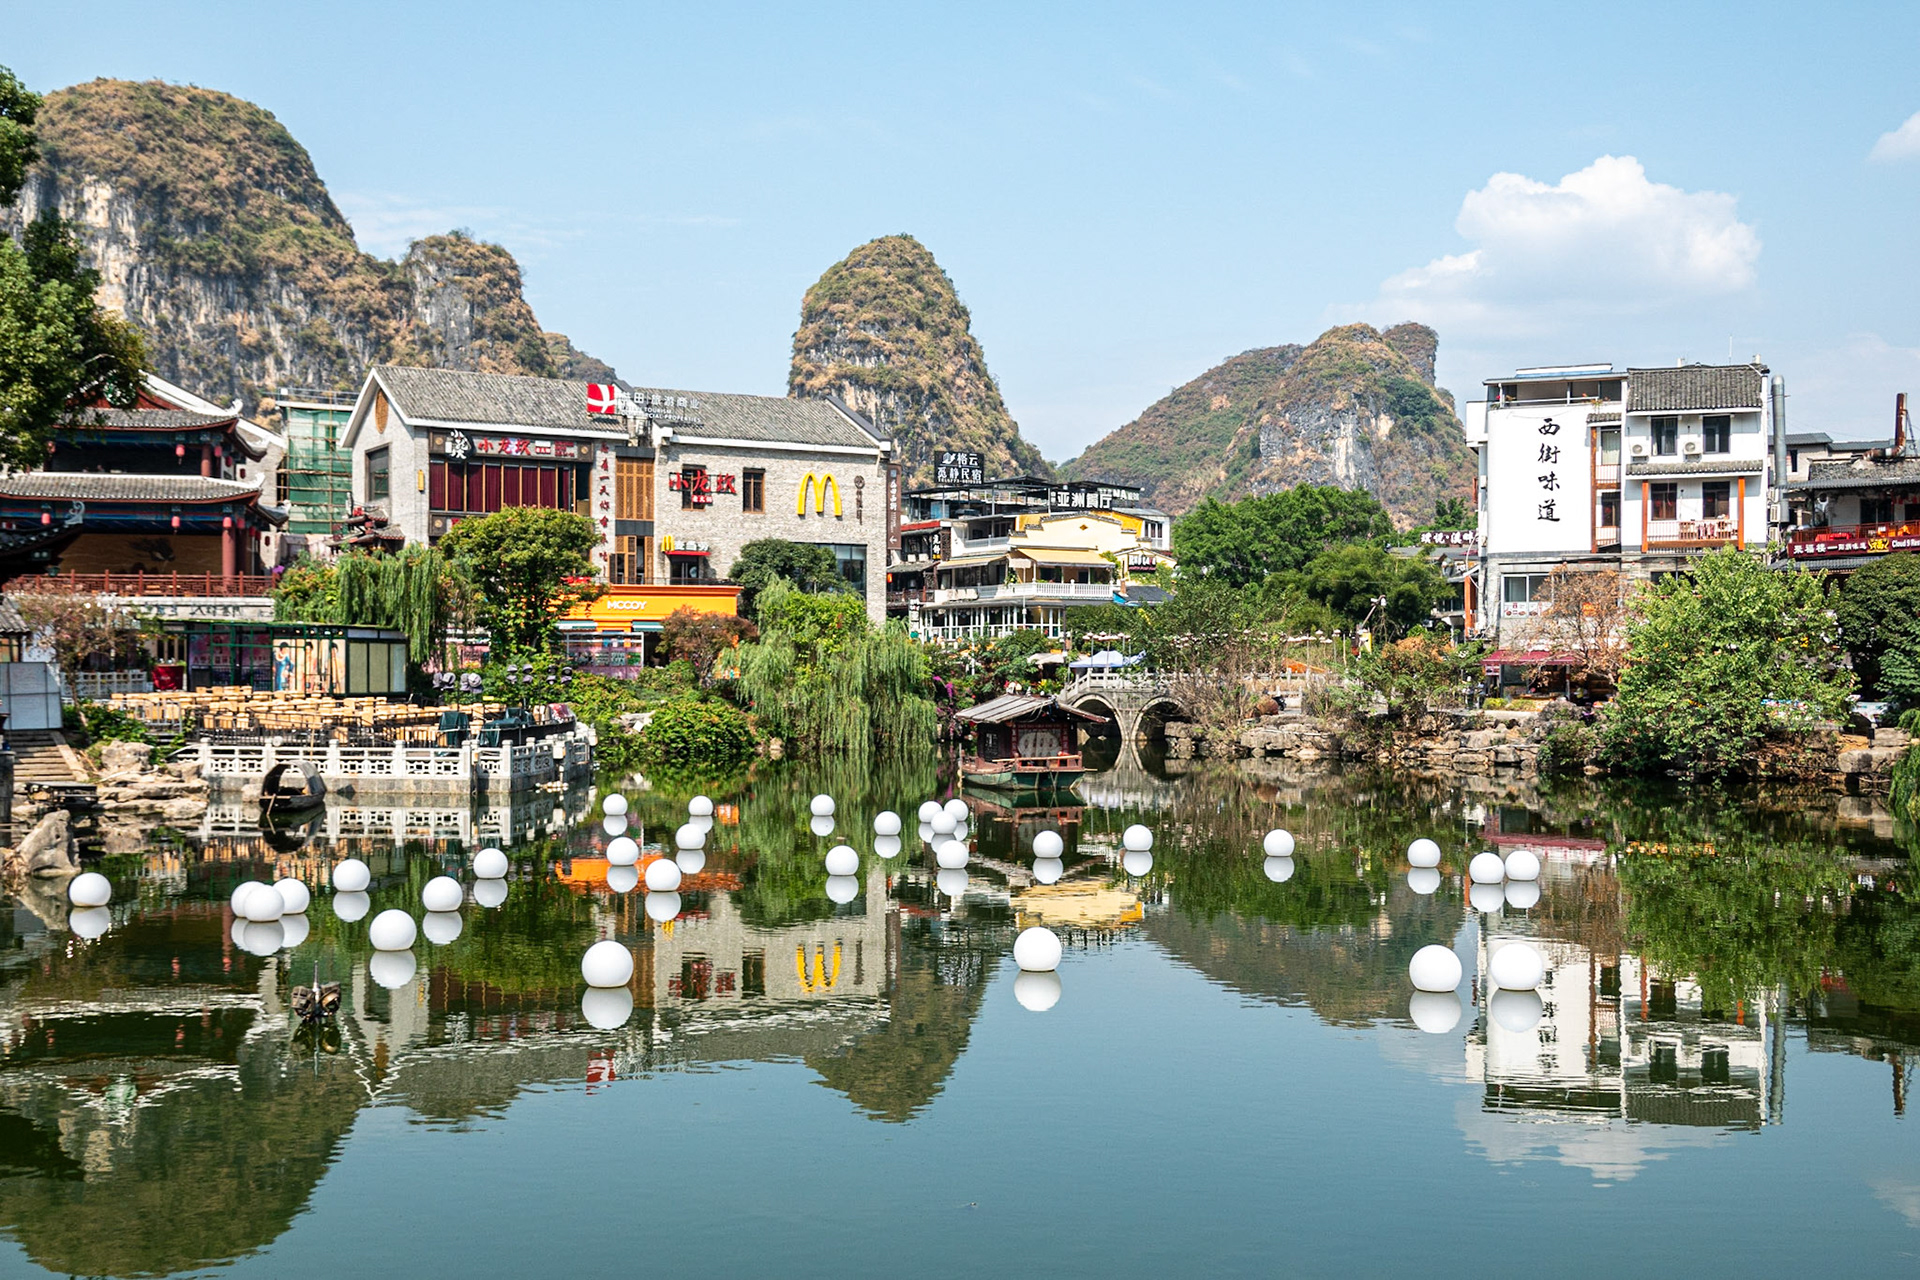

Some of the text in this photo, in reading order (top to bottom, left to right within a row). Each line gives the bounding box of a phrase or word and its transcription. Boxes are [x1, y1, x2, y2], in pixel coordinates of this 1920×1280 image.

[478, 437, 531, 456] 小龙坎
[1538, 418, 1561, 522] 西街味道
[669, 469, 736, 494] 小龙坎
[1057, 491, 1113, 508] 亚洲餐厅
[1891, 539, 1906, 548] Cloud
